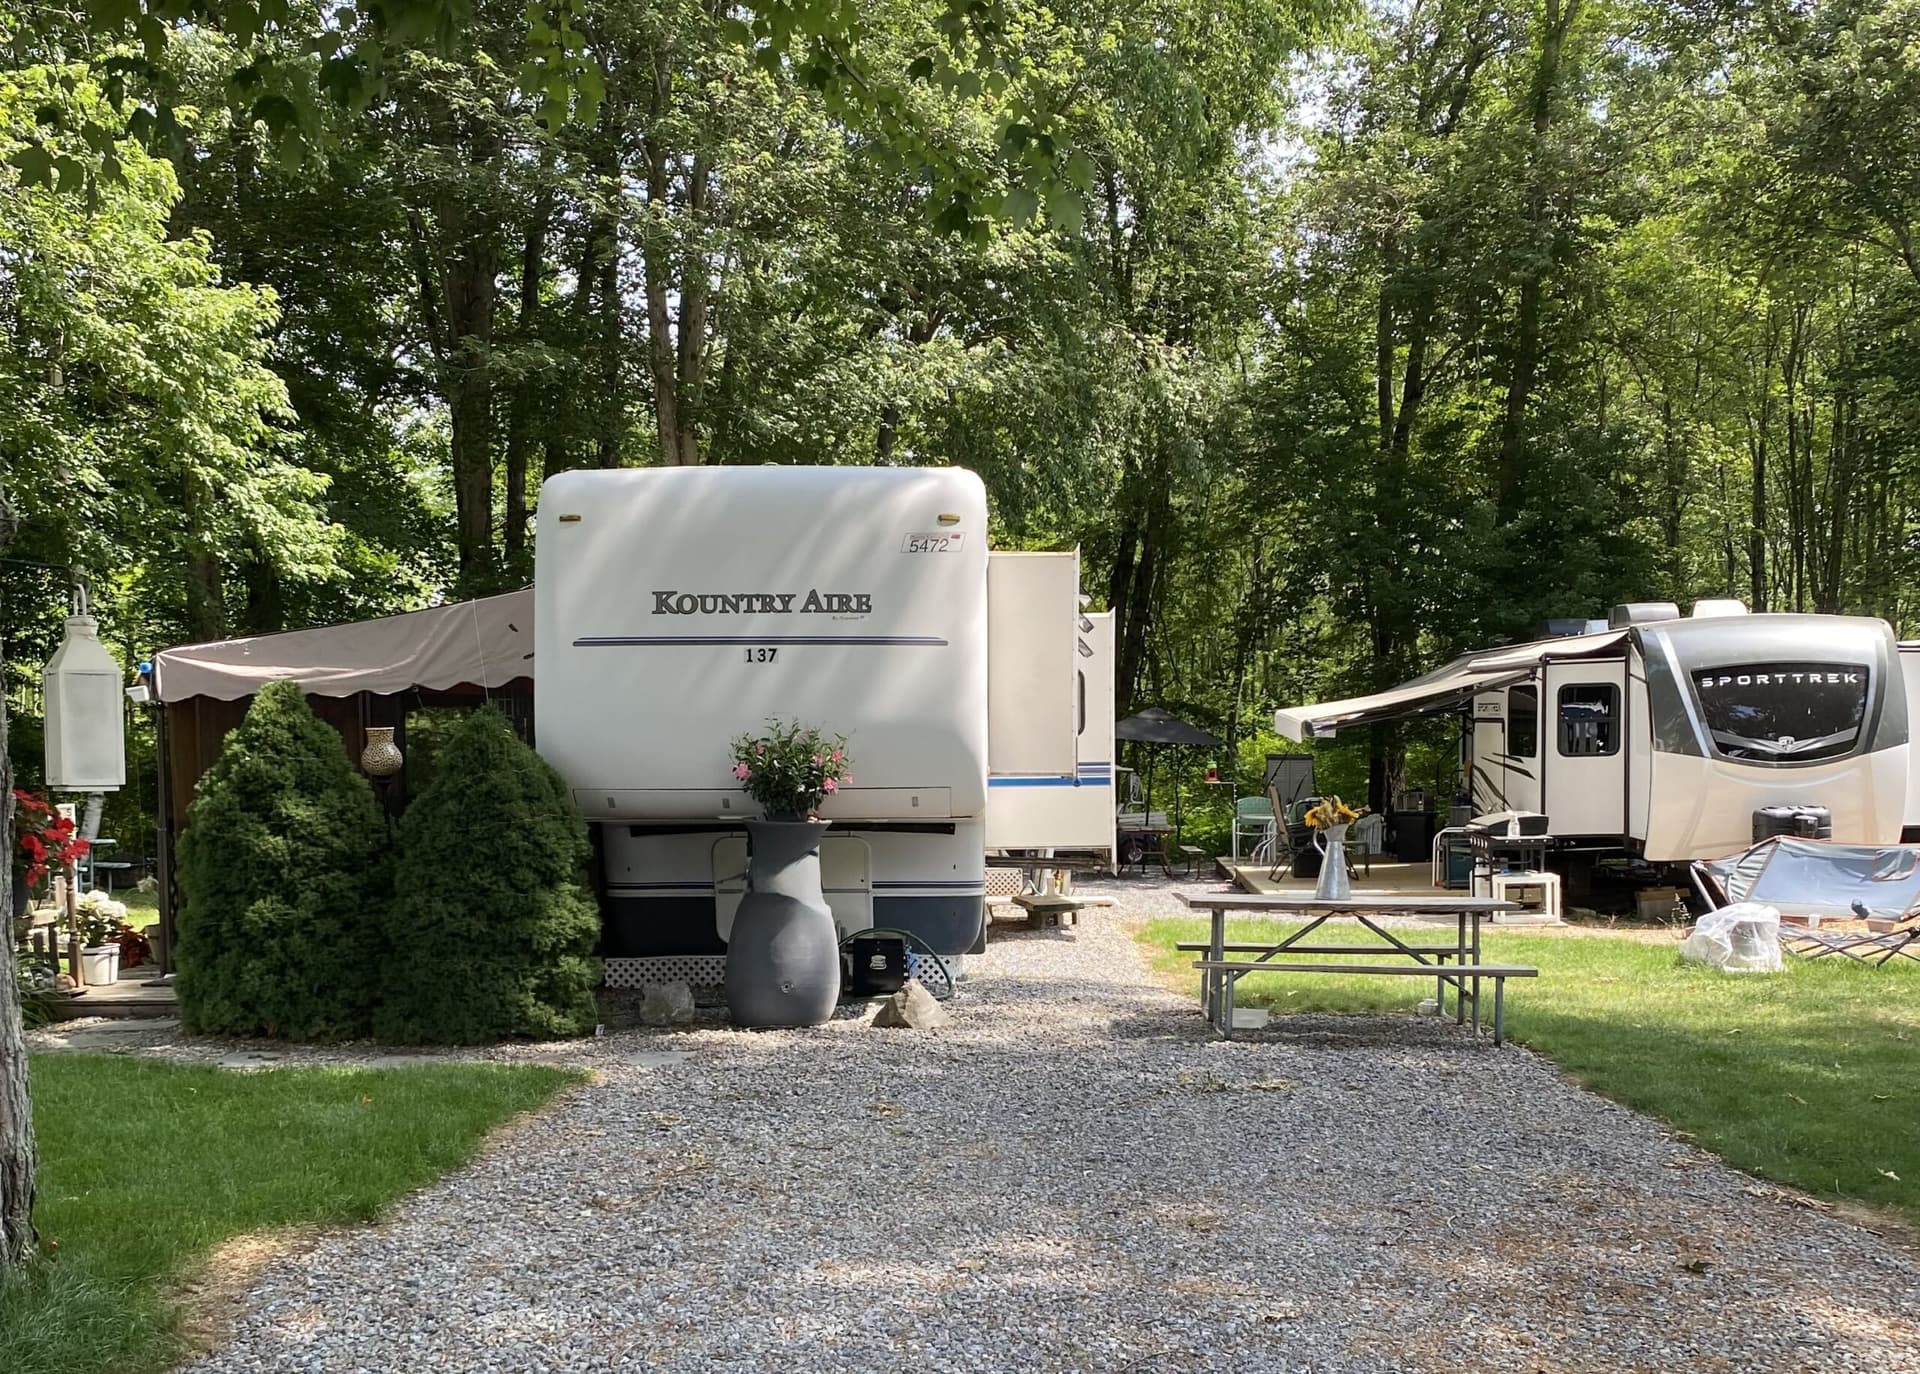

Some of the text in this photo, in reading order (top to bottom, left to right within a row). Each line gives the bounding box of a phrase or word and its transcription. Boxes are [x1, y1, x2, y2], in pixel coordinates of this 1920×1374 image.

[909, 538, 949, 553] 5472
[652, 589, 873, 615] KOUNTRY AIRE
[746, 648, 778, 663] 137
[1701, 673, 1858, 687] SPORTTREK
